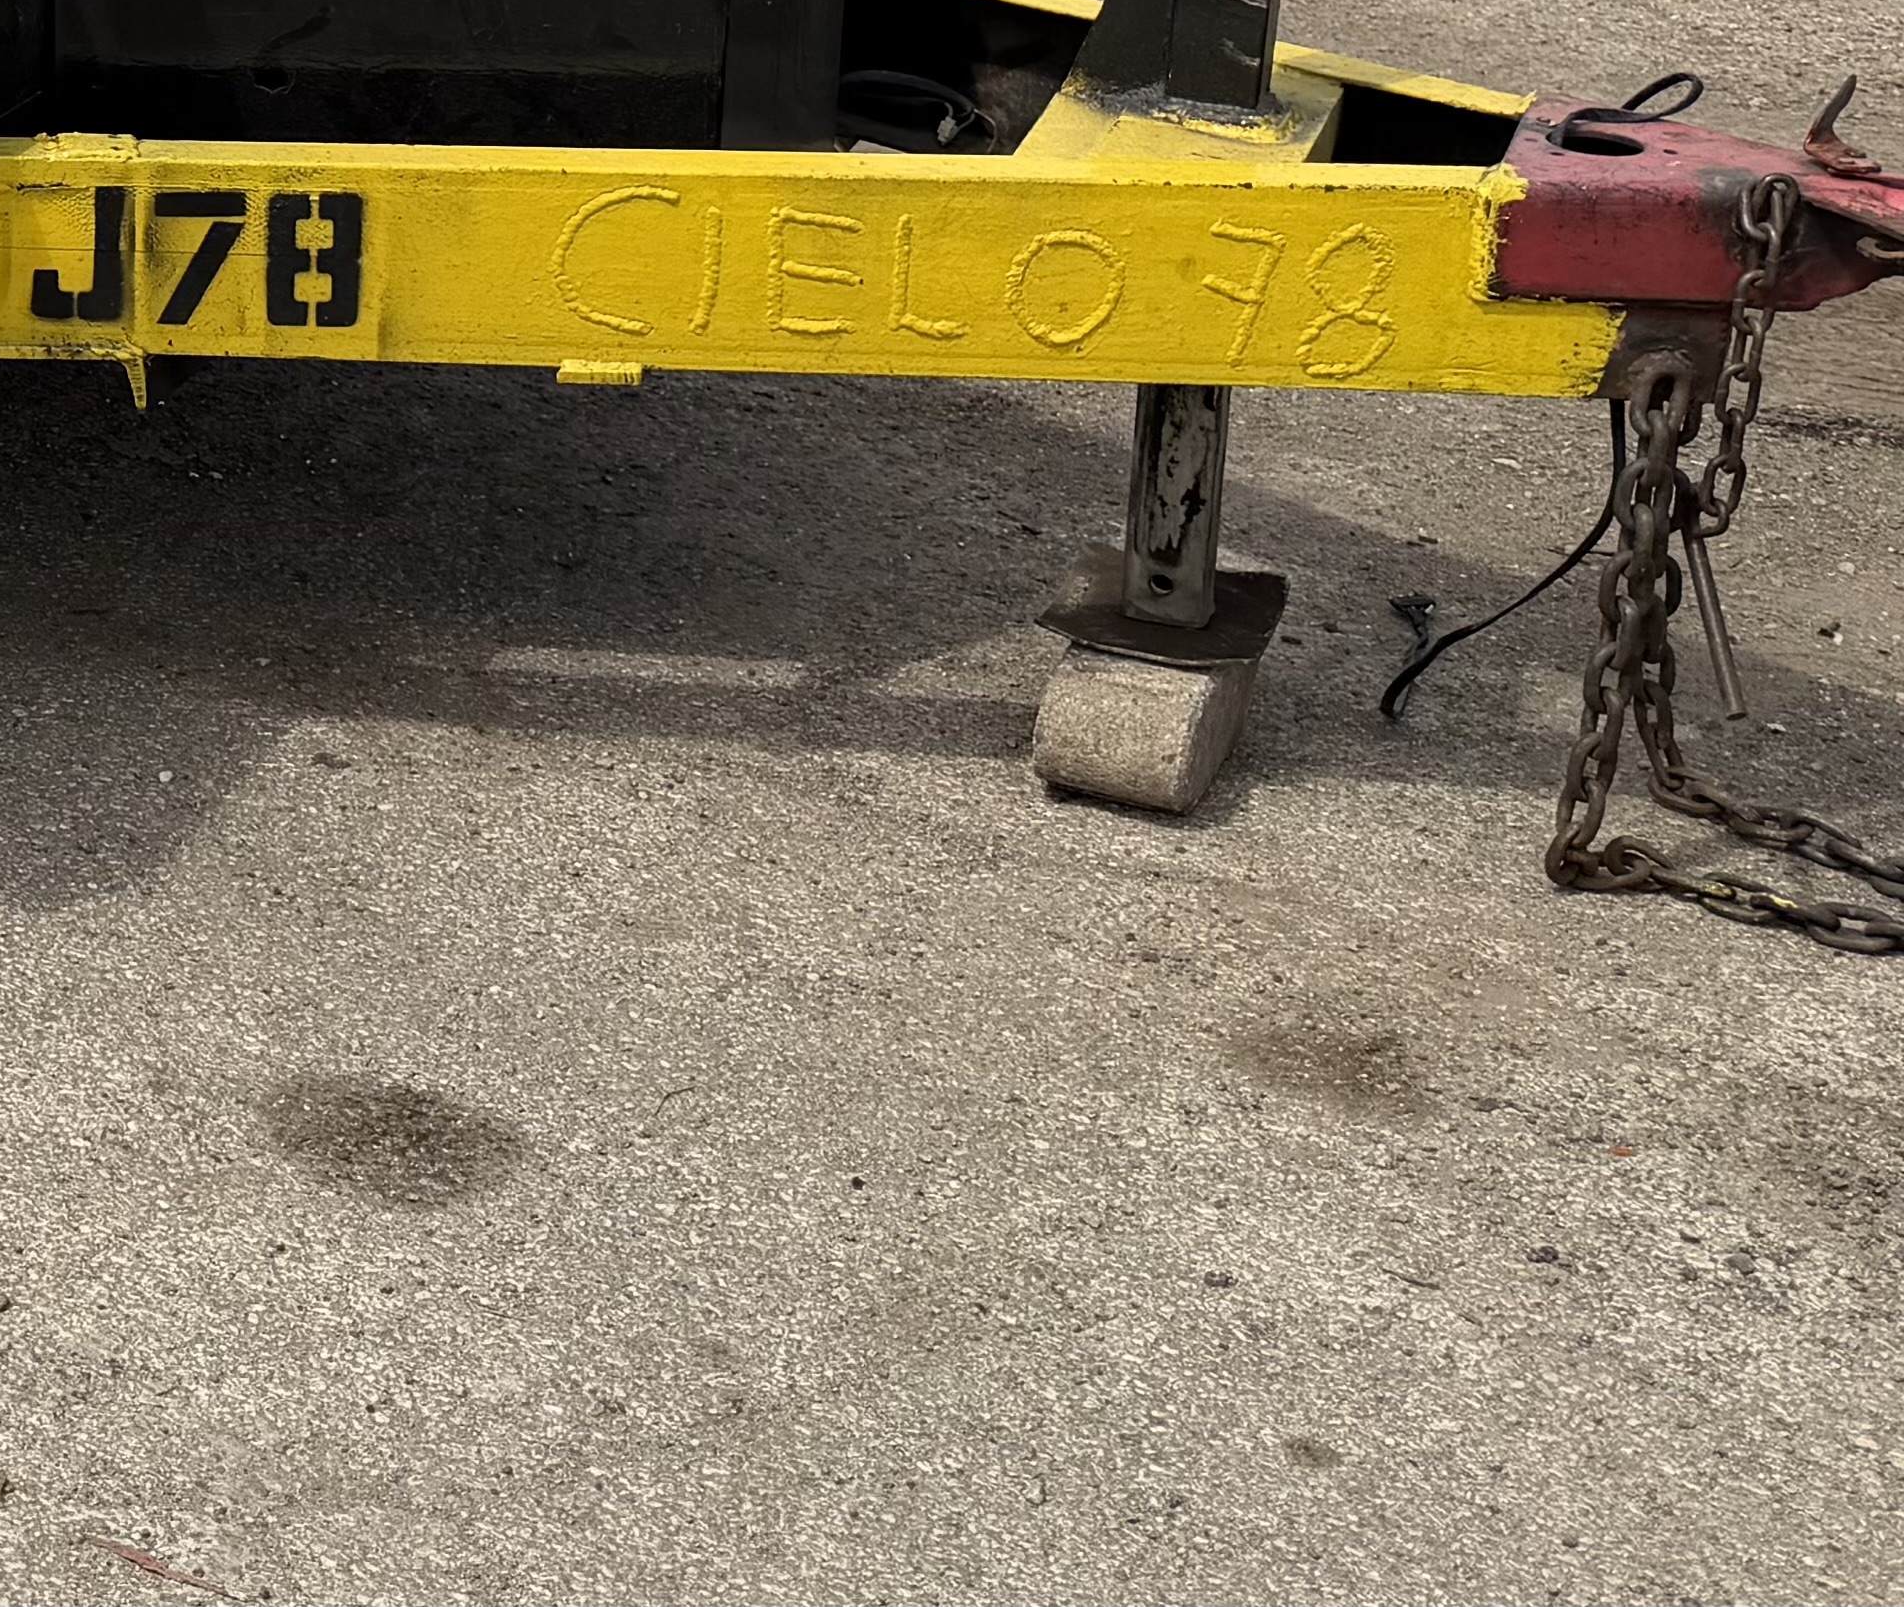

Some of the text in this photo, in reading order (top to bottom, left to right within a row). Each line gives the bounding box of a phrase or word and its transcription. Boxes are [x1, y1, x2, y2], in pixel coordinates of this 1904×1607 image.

[30, 186, 363, 327] J78
[549, 184, 1395, 379] CIELO 78
